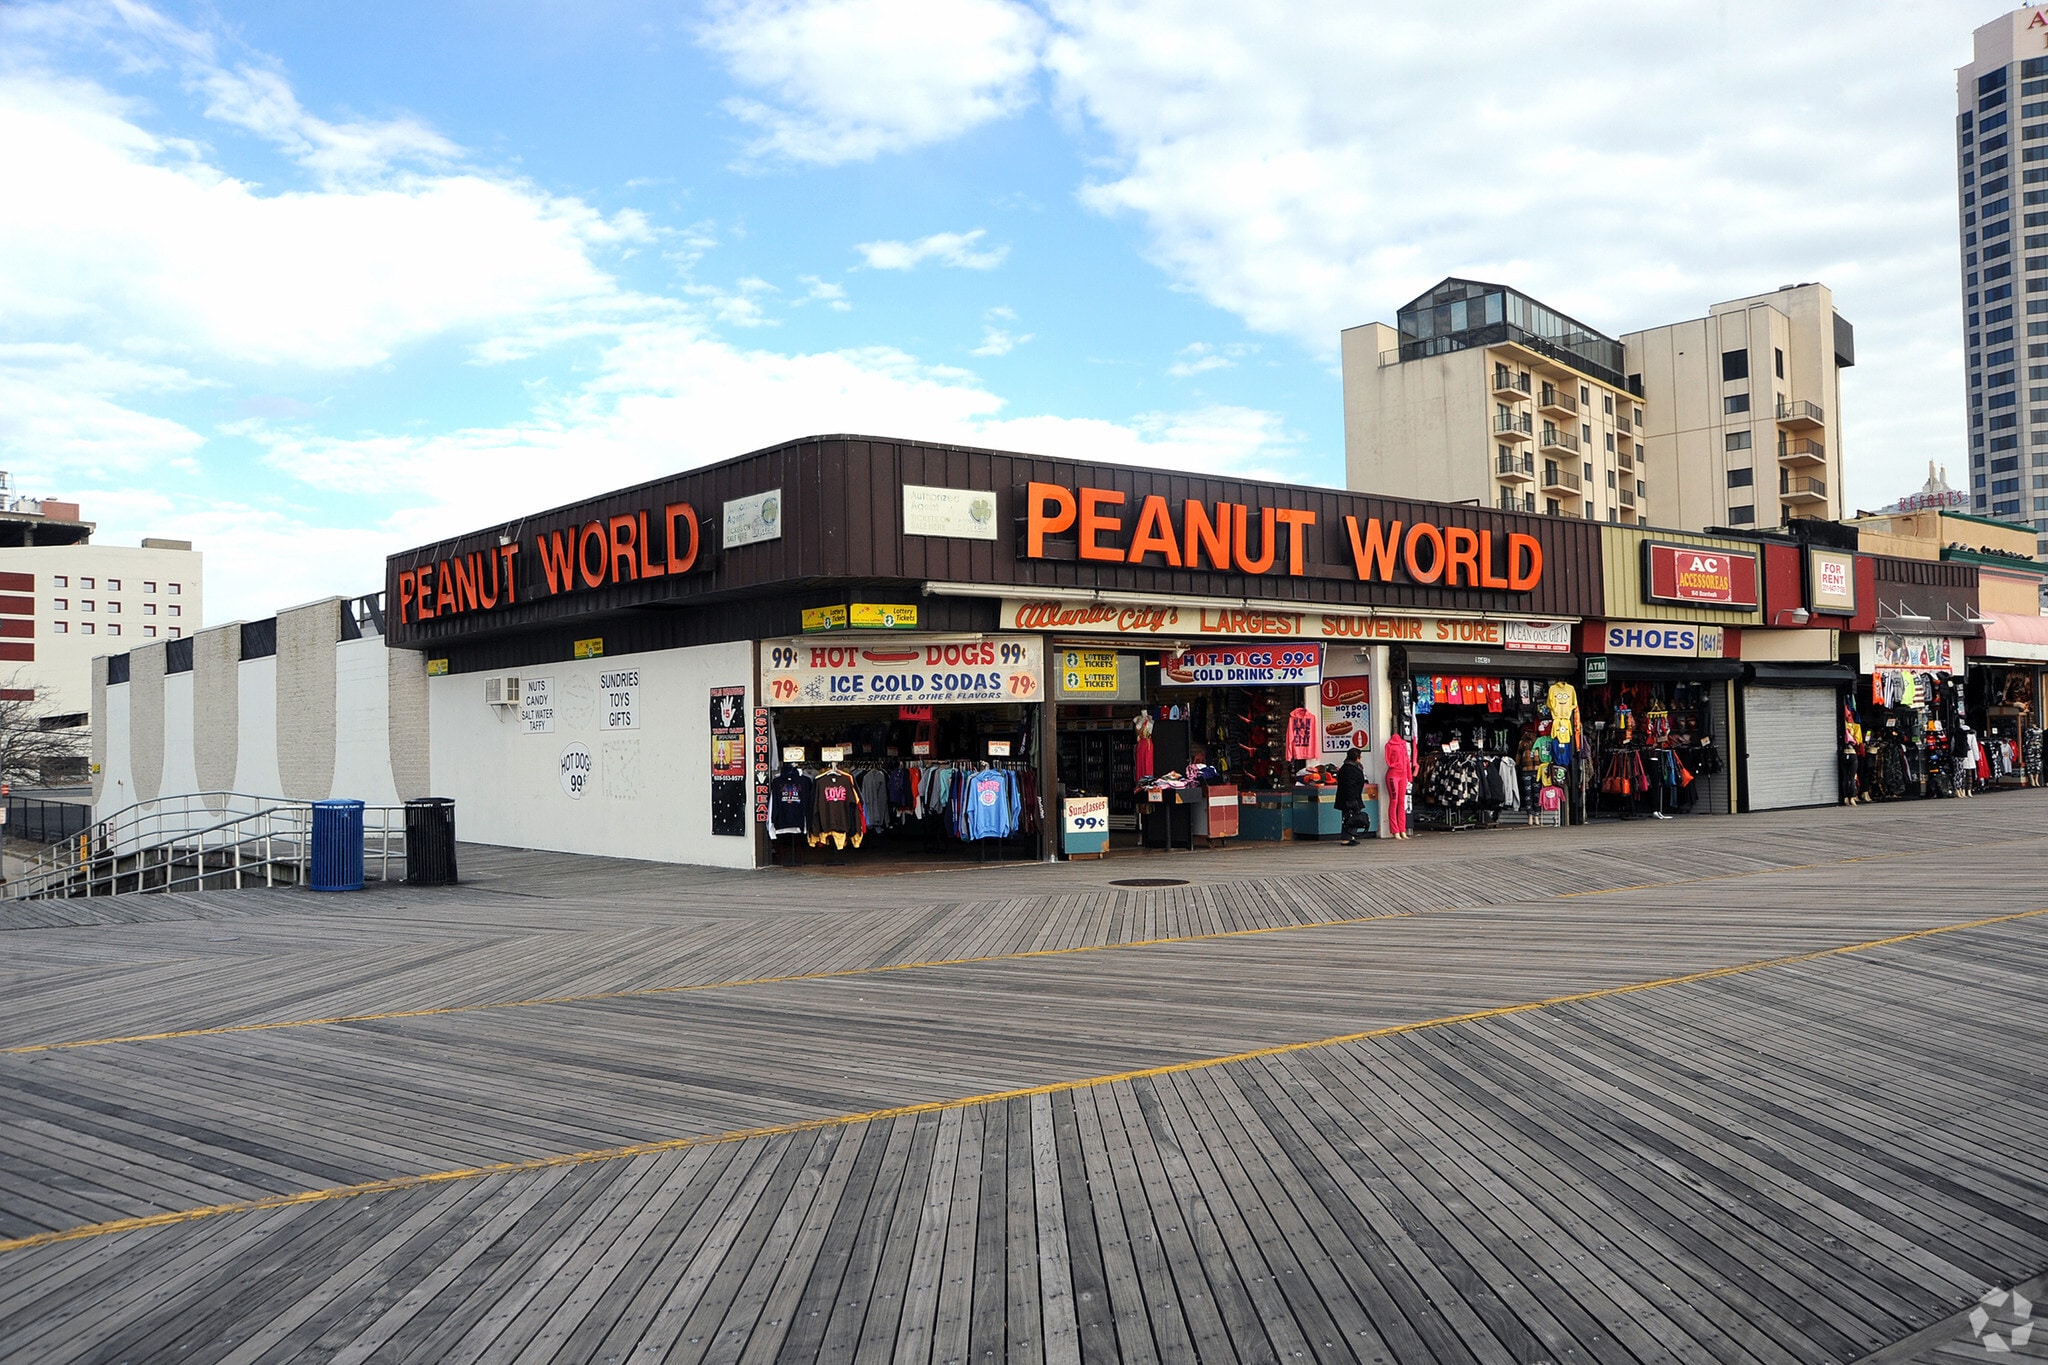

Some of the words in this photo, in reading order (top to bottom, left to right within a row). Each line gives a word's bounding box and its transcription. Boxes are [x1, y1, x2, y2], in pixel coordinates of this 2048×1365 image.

[1899, 490, 1963, 511] RESORTS
[1027, 481, 1316, 577] PEANUT
[1345, 515, 1544, 592] WORLD
[399, 543, 519, 624] PEANUT
[536, 502, 700, 596] WORLD
[1689, 556, 1718, 573] AC
[1825, 563, 1841, 575] FOR
[1822, 573, 1845, 585] RENT
[893, 607, 914, 616] Lottery
[896, 614, 915, 622] Tickets
[1015, 602, 1118, 629] Atlantic
[1117, 605, 1179, 633] City's
[1200, 607, 1306, 635] LARGEST
[1322, 614, 1423, 640] SOUVENIR
[1436, 621, 1498, 643] STORE
[1533, 630, 1547, 642] ONE
[1608, 628, 1695, 650] SHOES
[1700, 634, 1716, 652] 1641
[772, 647, 798, 669] 99¢
[810, 647, 859, 668] HOT
[925, 641, 995, 666] DOGS
[1000, 643, 1027, 664] 99¢
[1083, 653, 1114, 661] LOTTERY
[1183, 652, 1218, 667] HOT
[1223, 652, 1272, 666] DOGS
[1084, 660, 1113, 668] TICKETS
[1588, 662, 1605, 672] ATM
[600, 671, 639, 689] SUNDRIES
[1084, 673, 1115, 681] LOTTERY
[1193, 668, 1224, 682] COLD
[1227, 668, 1274, 681] DRINKS
[528, 680, 546, 692] NUTS
[772, 680, 799, 699] 79¢
[830, 674, 864, 693] ICE
[871, 674, 925, 693] COLD
[930, 672, 1002, 691] SODAS
[1009, 675, 1036, 695] 79¢
[525, 694, 549, 706] CANDY
[609, 692, 630, 708] TOYS
[830, 694, 857, 702] COKE
[867, 693, 901, 702] SPRITE
[906, 693, 914, 701] &
[918, 692, 953, 701] OTHER
[957, 691, 1002, 699] FLAVORS
[521, 709, 535, 721] SALT
[535, 708, 554, 720] WATER
[608, 711, 631, 727] GIFTS
[529, 720, 546, 731] TAFFY
[755, 708, 768, 772] PSYCHIC
[1326, 740, 1351, 749] $1.99
[560, 753, 575, 776] HOT
[570, 773, 587, 792] 99¢
[977, 780, 1000, 793] LOVE
[825, 786, 847, 801] LOVE
[756, 785, 768, 822] READ
[1068, 801, 1106, 817] Sunglasses
[1074, 817, 1105, 830] 99¢
